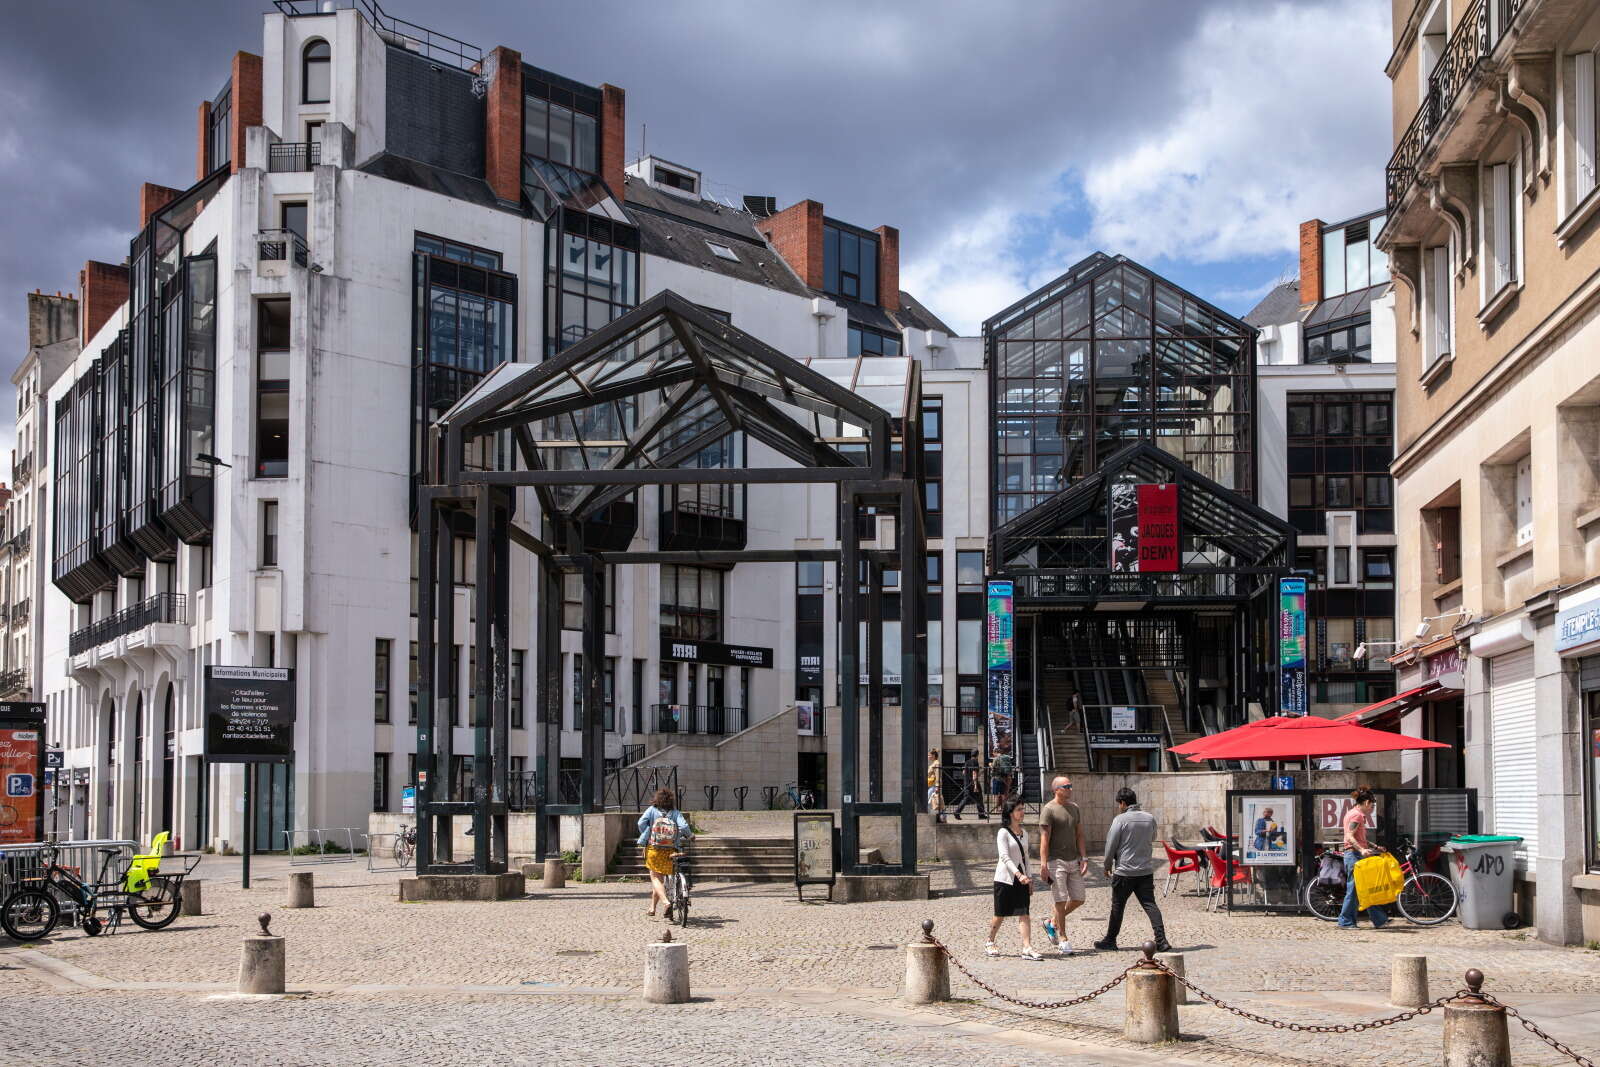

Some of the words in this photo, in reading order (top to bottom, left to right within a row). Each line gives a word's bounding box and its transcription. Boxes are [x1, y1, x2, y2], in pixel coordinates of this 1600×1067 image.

[1142, 524, 1174, 538] JACQUES
[1142, 546, 1176, 560] DEMY
[1567, 610, 1594, 637] TEMPLE
[214, 668, 250, 677] Informations
[252, 670, 286, 678] Municipales
[11, 777, 21, 793] P
